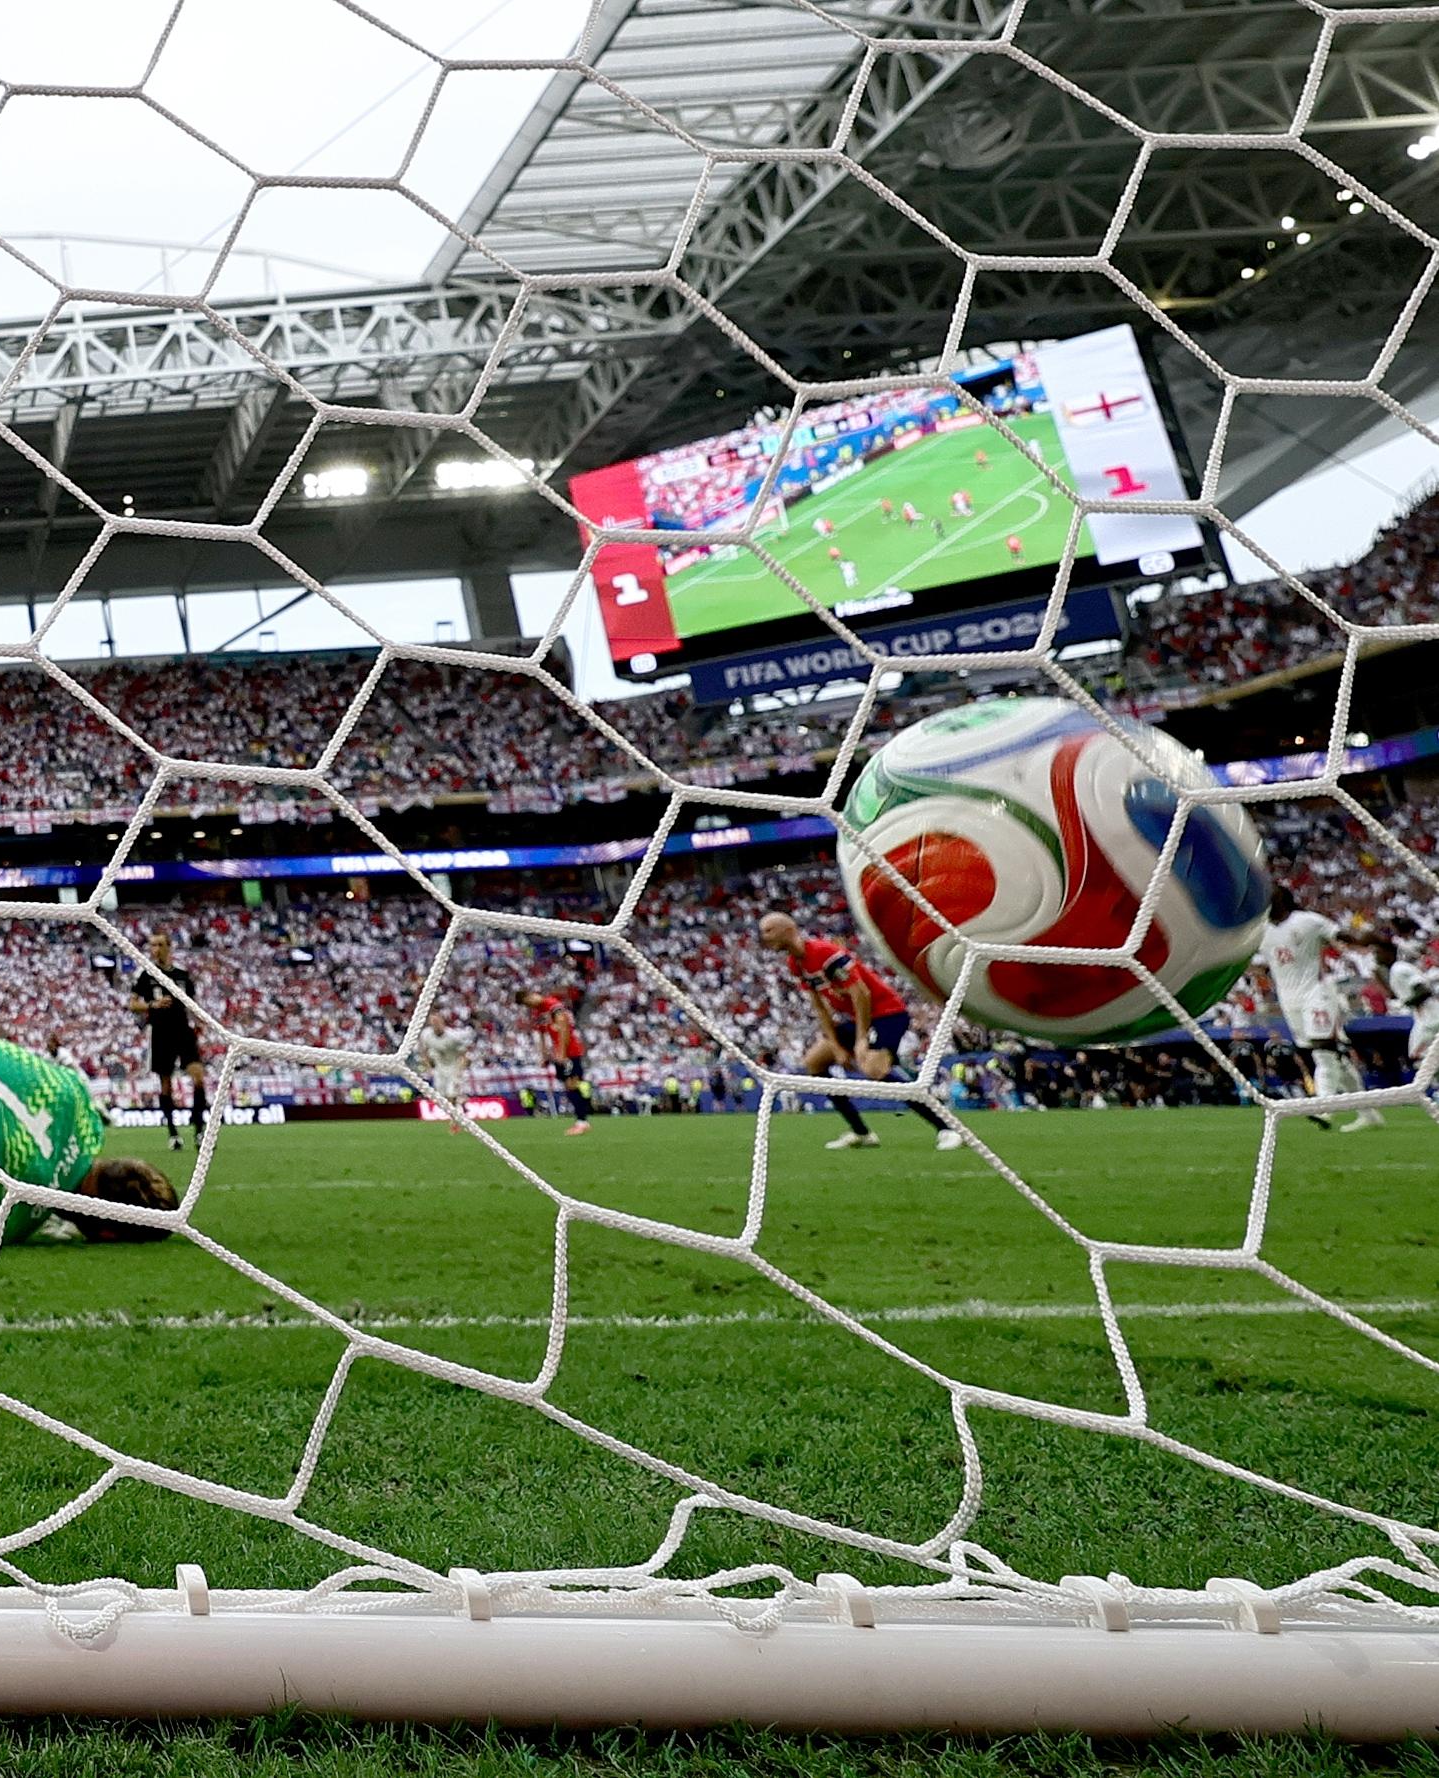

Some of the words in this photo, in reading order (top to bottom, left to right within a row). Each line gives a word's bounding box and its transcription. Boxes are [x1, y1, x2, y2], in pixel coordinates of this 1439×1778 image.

[1102, 466, 1146, 497] 1
[612, 572, 649, 606] 1
[724, 660, 784, 689] FIFA
[889, 629, 952, 657] CUP
[110, 1106, 192, 1127] Smarer
[223, 1104, 255, 1125] for
[258, 1102, 286, 1125] all
